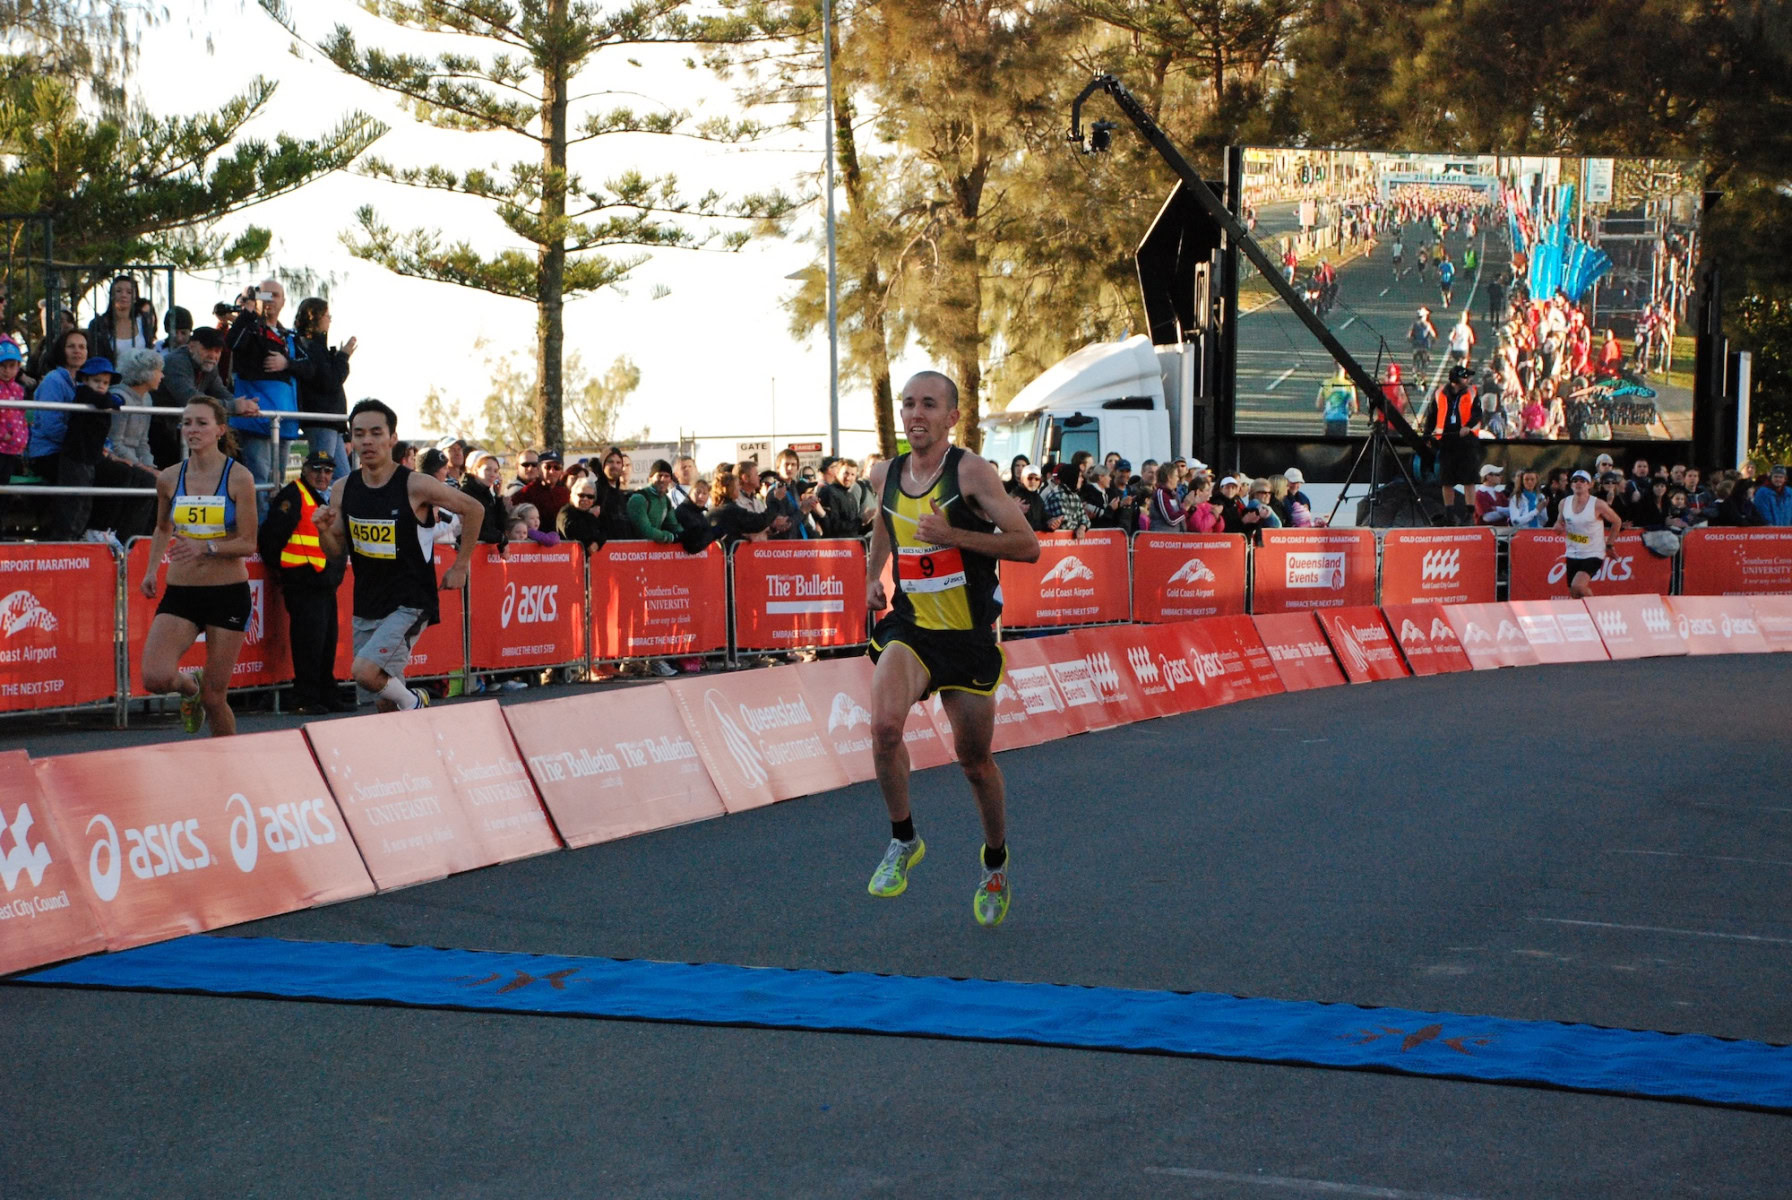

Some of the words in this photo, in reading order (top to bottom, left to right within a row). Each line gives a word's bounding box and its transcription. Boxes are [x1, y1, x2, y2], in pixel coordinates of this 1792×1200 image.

[188, 507, 206, 523] 51
[353, 524, 391, 542] 4502
[1400, 535, 1415, 543] GOLD
[1415, 535, 1432, 543] COAST
[1432, 535, 1453, 543] AIRPORT
[1454, 534, 1482, 542] MARATHON
[1533, 535, 1554, 543] GOLD
[1037, 539, 1054, 547] OAST
[1055, 539, 1078, 547] AIRPORT
[1080, 538, 1111, 546] MARATHON
[1182, 541, 1203, 549] AIRPORT
[1204, 541, 1231, 549] MARATHON
[1270, 536, 1287, 544] GOLD
[1287, 536, 1304, 544] COAST
[1305, 536, 1329, 544] AIRPORT
[1329, 536, 1360, 544] MARATHON
[520, 554, 541, 562] AIRPORT
[542, 553, 570, 562] MARATHON
[609, 552, 627, 560] GOLD
[628, 552, 647, 560] COAST
[648, 551, 673, 560] AIRPORT
[754, 550, 771, 558] GOLD
[773, 550, 792, 558] COAST
[793, 550, 818, 558] AIRPORT
[819, 549, 852, 558] MARATHON
[37, 557, 89, 571] MARATHON
[920, 556, 934, 577] 9
[1288, 557, 1341, 569] Queensland
[1742, 566, 1791, 574] UNIVERSITY
[1288, 571, 1319, 583] Events
[645, 586, 672, 597] Southern
[673, 584, 689, 595] Cross
[766, 575, 790, 596] The
[795, 574, 843, 596] Bulletin
[1041, 589, 1055, 598] Gold
[1056, 588, 1073, 598] Coast
[1074, 588, 1094, 598] Airport
[1167, 589, 1179, 597] Gold
[1180, 589, 1195, 597] Coast
[1196, 589, 1214, 598] Airport
[645, 598, 690, 611] UNIVERSITY
[1036, 608, 1061, 618] EMBRACE
[1062, 608, 1072, 616] THE
[1072, 607, 1086, 616] NEXT
[1087, 607, 1099, 615] STEP
[772, 629, 798, 638] EMBRACE
[628, 637, 654, 647] EMBRACE
[655, 636, 665, 645] THE
[0, 648, 20, 662] oast
[23, 646, 57, 663] Airport
[522, 645, 531, 655] THE
[531, 645, 543, 654] NEXT
[543, 644, 555, 653] STEP
[414, 654, 428, 664] STEP
[232, 662, 246, 674] EXT
[247, 661, 264, 672] STEP
[1055, 665, 1091, 683] Queensland
[1, 683, 19, 696] THE
[20, 682, 42, 694] NEXT
[44, 679, 64, 692] STEP
[1062, 685, 1087, 700] Events
[1023, 693, 1044, 708] vents
[739, 693, 812, 736] Queensland
[759, 732, 827, 766] Government
[530, 755, 566, 784] The
[563, 748, 621, 777] Bulletin
[616, 741, 648, 768] The
[645, 736, 698, 763] Bulletin
[353, 776, 401, 800] Southern
[402, 773, 433, 794] Cross
[467, 779, 535, 805] UNIVERSITY
[366, 795, 442, 826] UNIVERSITY
[13, 899, 35, 918] City
[34, 890, 70, 912] Council
